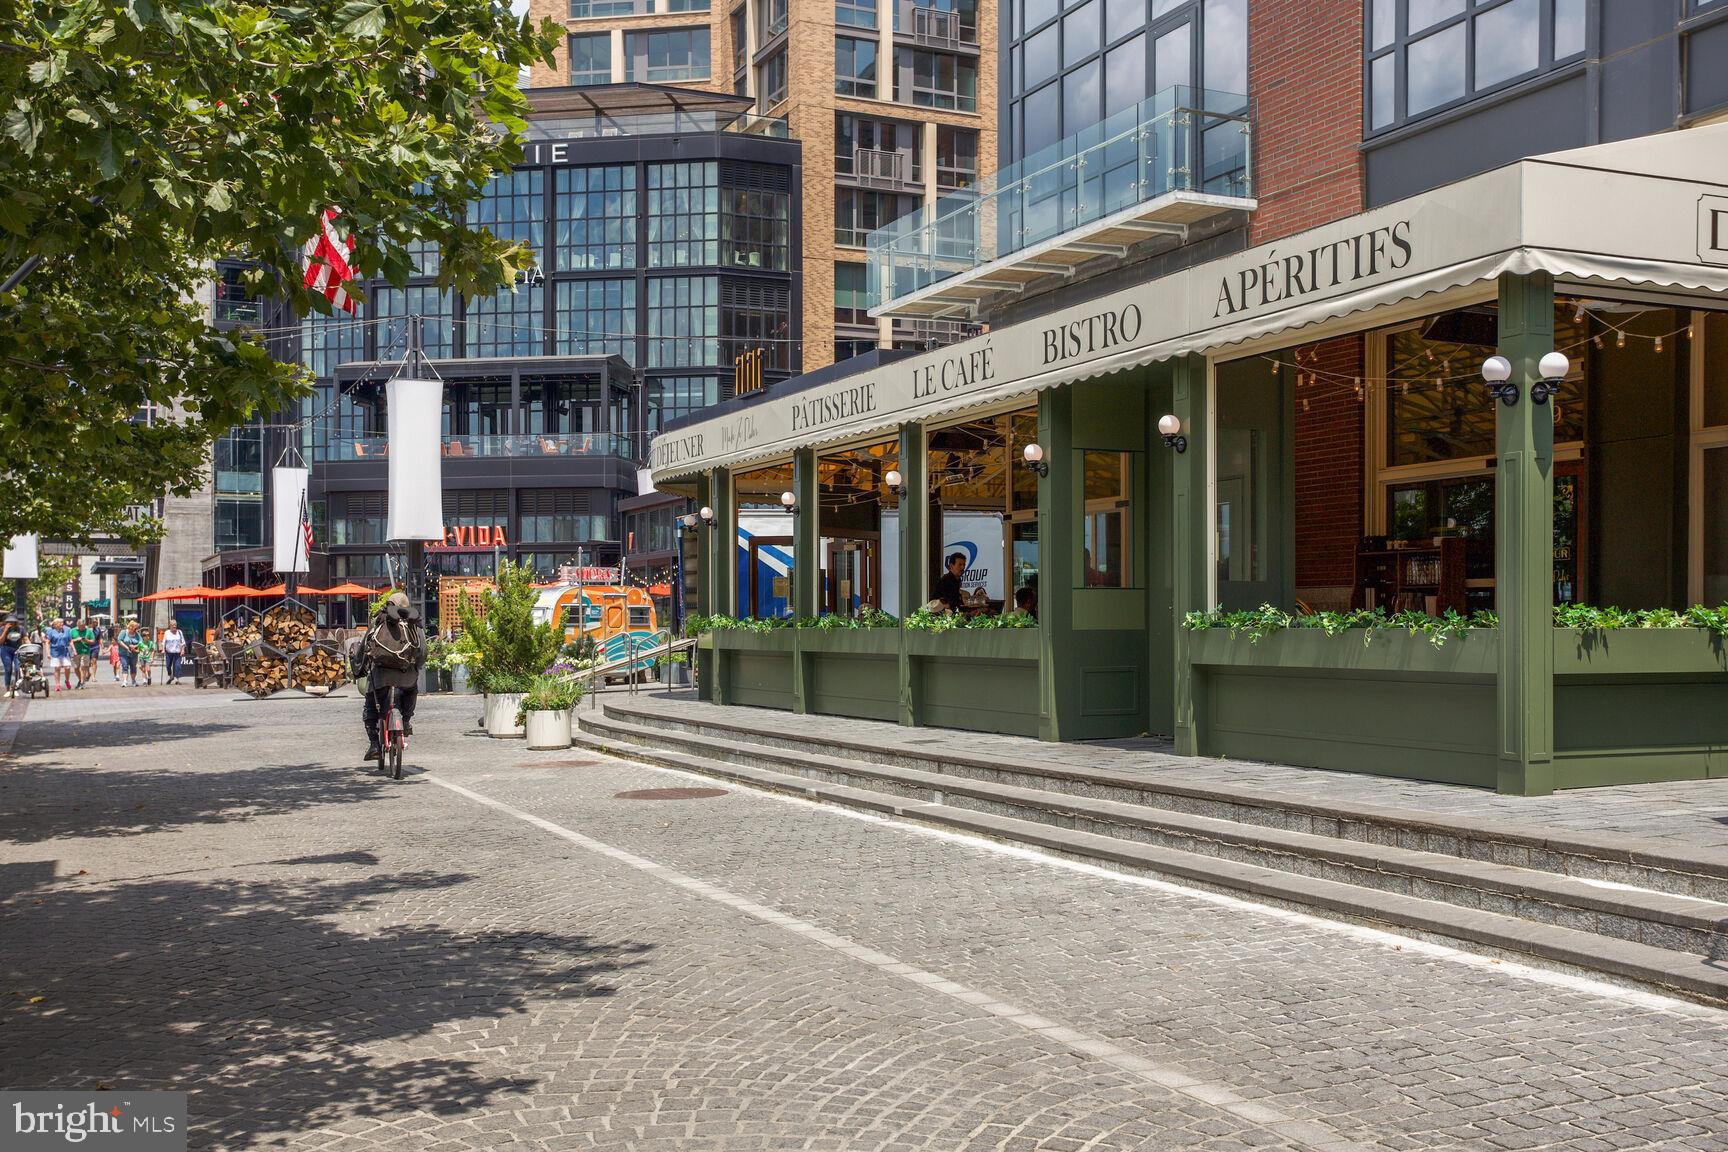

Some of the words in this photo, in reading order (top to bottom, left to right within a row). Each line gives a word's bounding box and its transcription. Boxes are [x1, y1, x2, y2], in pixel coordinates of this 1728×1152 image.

[521, 143, 569, 164] IE
[1212, 220, 1412, 318] APÉRITIFS
[1042, 303, 1142, 365] BISTRO
[912, 362, 936, 399] LE
[941, 339, 995, 391] CAFÉ
[791, 383, 877, 431] PÂTISSERIE
[656, 433, 704, 467] DÉJEUNER
[453, 525, 507, 547] VIDA
